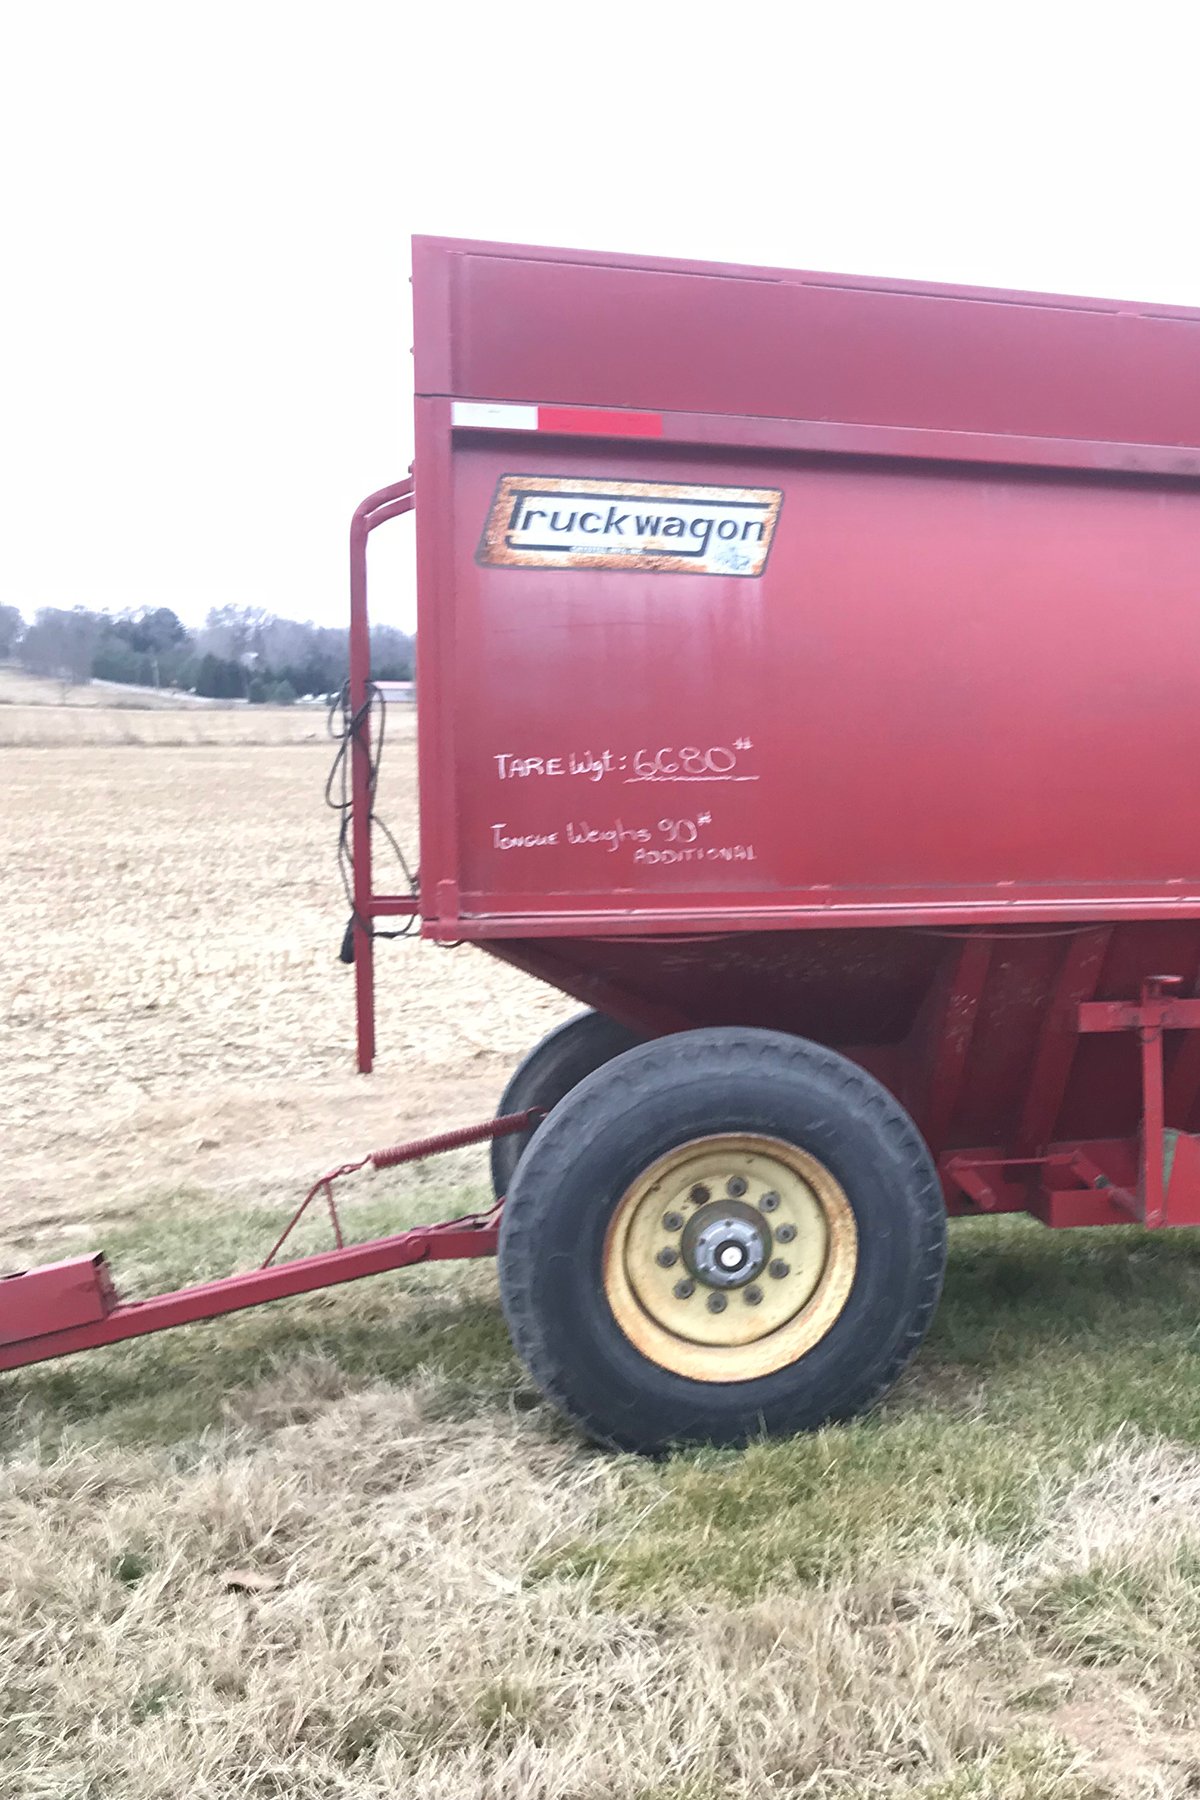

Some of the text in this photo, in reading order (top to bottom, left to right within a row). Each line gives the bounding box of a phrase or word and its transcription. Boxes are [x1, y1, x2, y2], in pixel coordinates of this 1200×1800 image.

[504, 489, 774, 558] Truckwagon
[493, 753, 566, 780] TARE
[633, 844, 758, 865] ADDITIONAL
